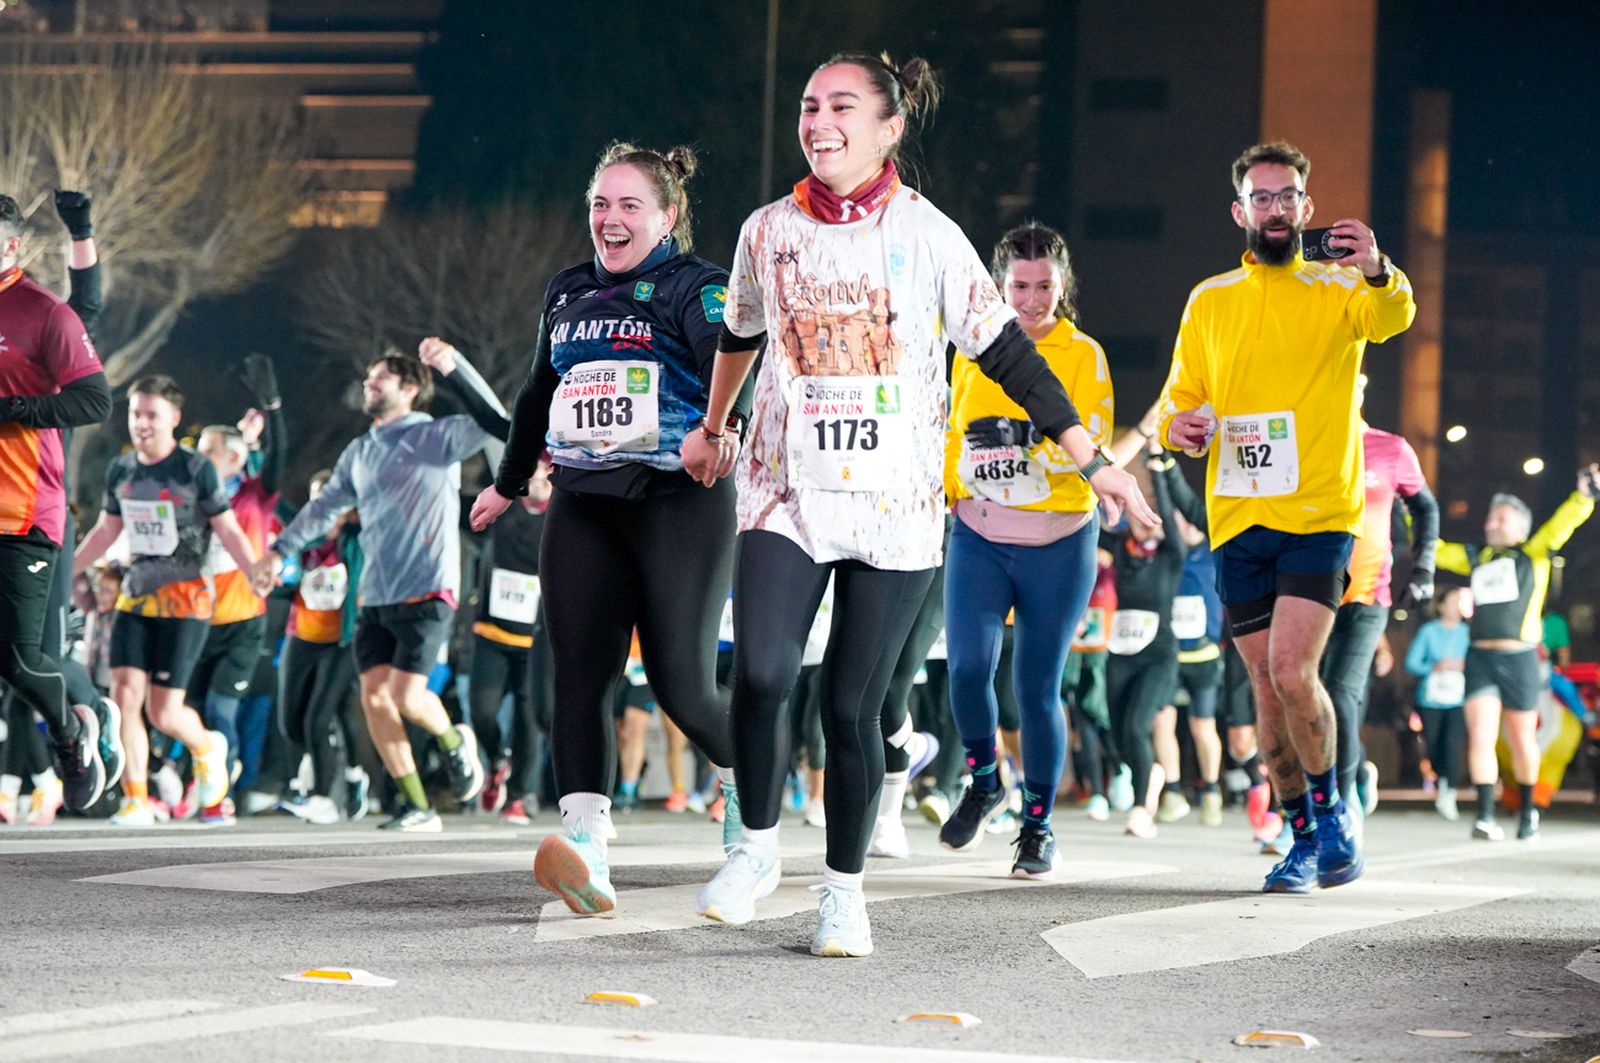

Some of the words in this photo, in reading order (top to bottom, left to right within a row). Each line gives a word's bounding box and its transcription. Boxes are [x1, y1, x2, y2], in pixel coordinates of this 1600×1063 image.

[550, 322, 570, 344] AN
[572, 315, 652, 341] ANTÓN
[573, 373, 601, 384] NOCHE
[604, 372, 617, 382] DE
[562, 386, 580, 399] SAN
[582, 383, 616, 398] ANTÓN
[849, 389, 863, 400] DE
[572, 397, 633, 429] 1183
[822, 401, 863, 415] ANTÓN
[591, 430, 612, 438] Sandra
[813, 418, 879, 451] 1173
[1249, 424, 1259, 432] DE
[970, 452, 986, 462] SAN
[1237, 443, 1272, 469] 452
[974, 459, 1030, 481] 4834
